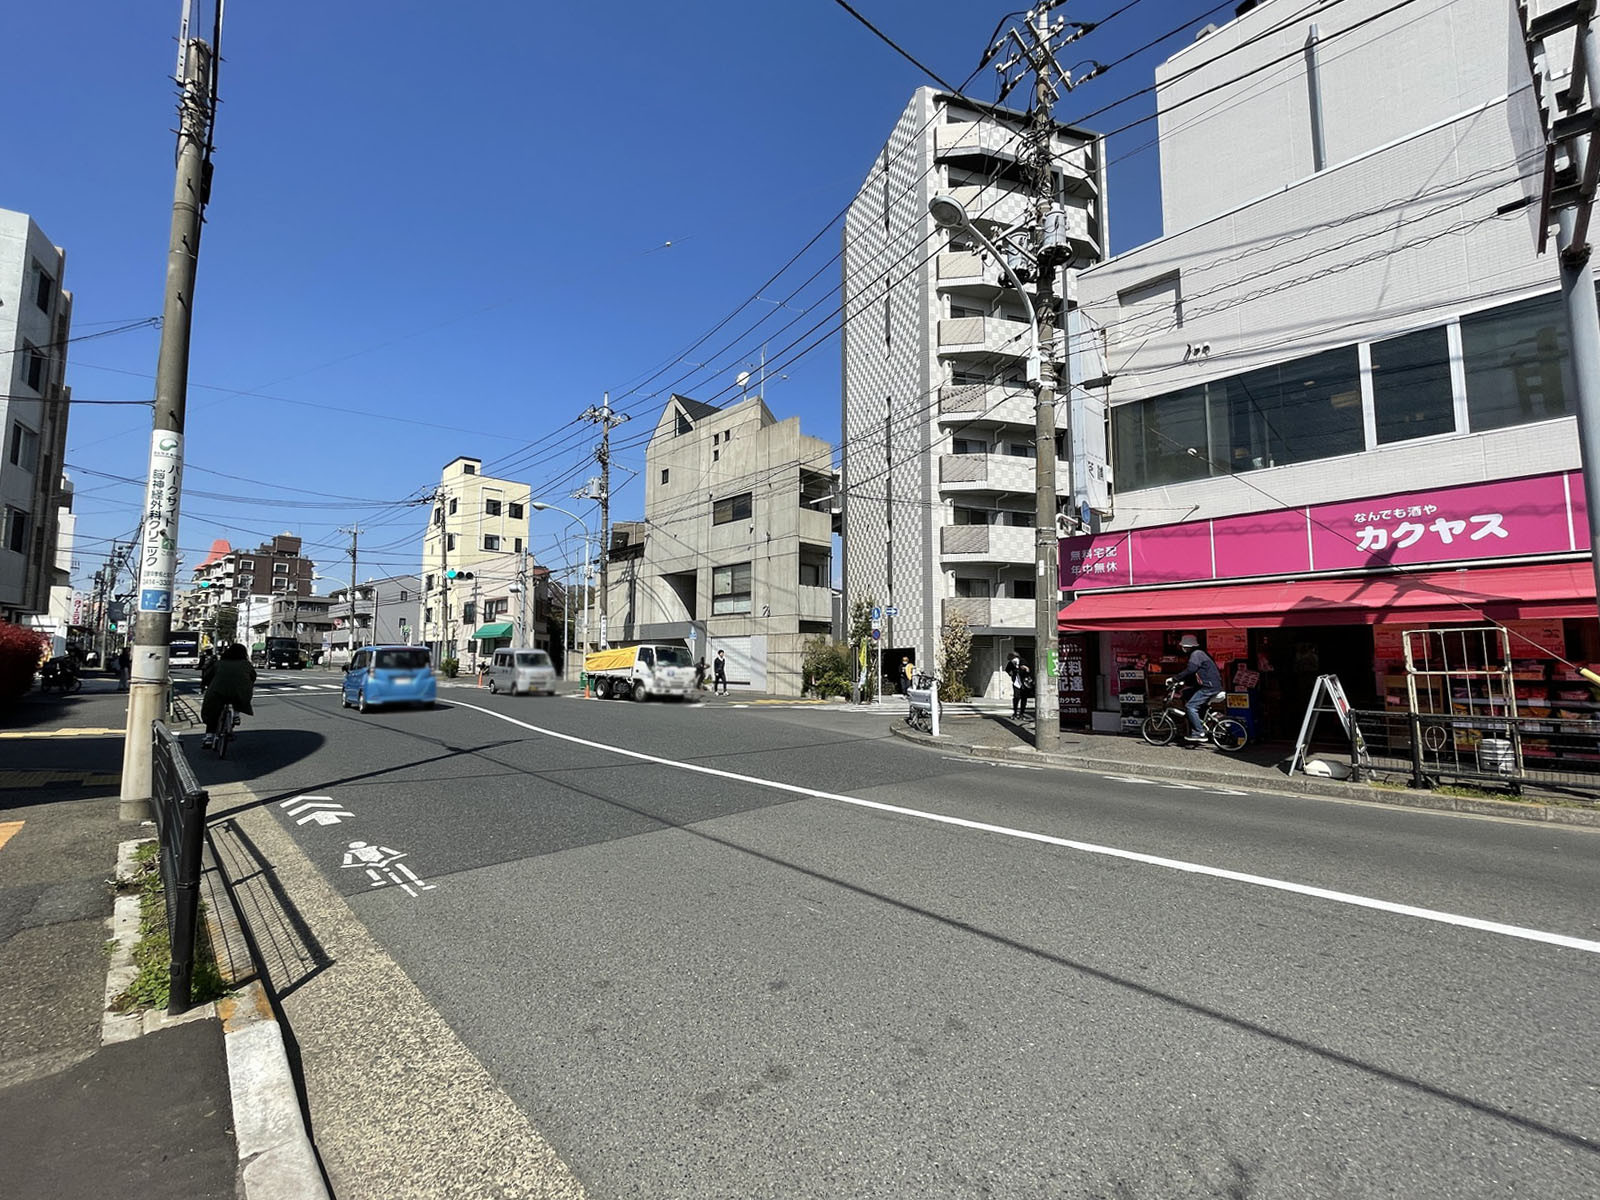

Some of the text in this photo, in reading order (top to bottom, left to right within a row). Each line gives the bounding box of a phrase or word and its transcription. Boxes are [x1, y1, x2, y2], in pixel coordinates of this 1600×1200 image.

[164, 464, 181, 527] パークサイド
[145, 468, 167, 567] 脳神経外科クリニック
[1354, 504, 1438, 523] なんでも酒や
[1355, 513, 1509, 552] カクヤス
[1070, 546, 1118, 561] 無料宅配
[1070, 561, 1119, 576] 年中無休
